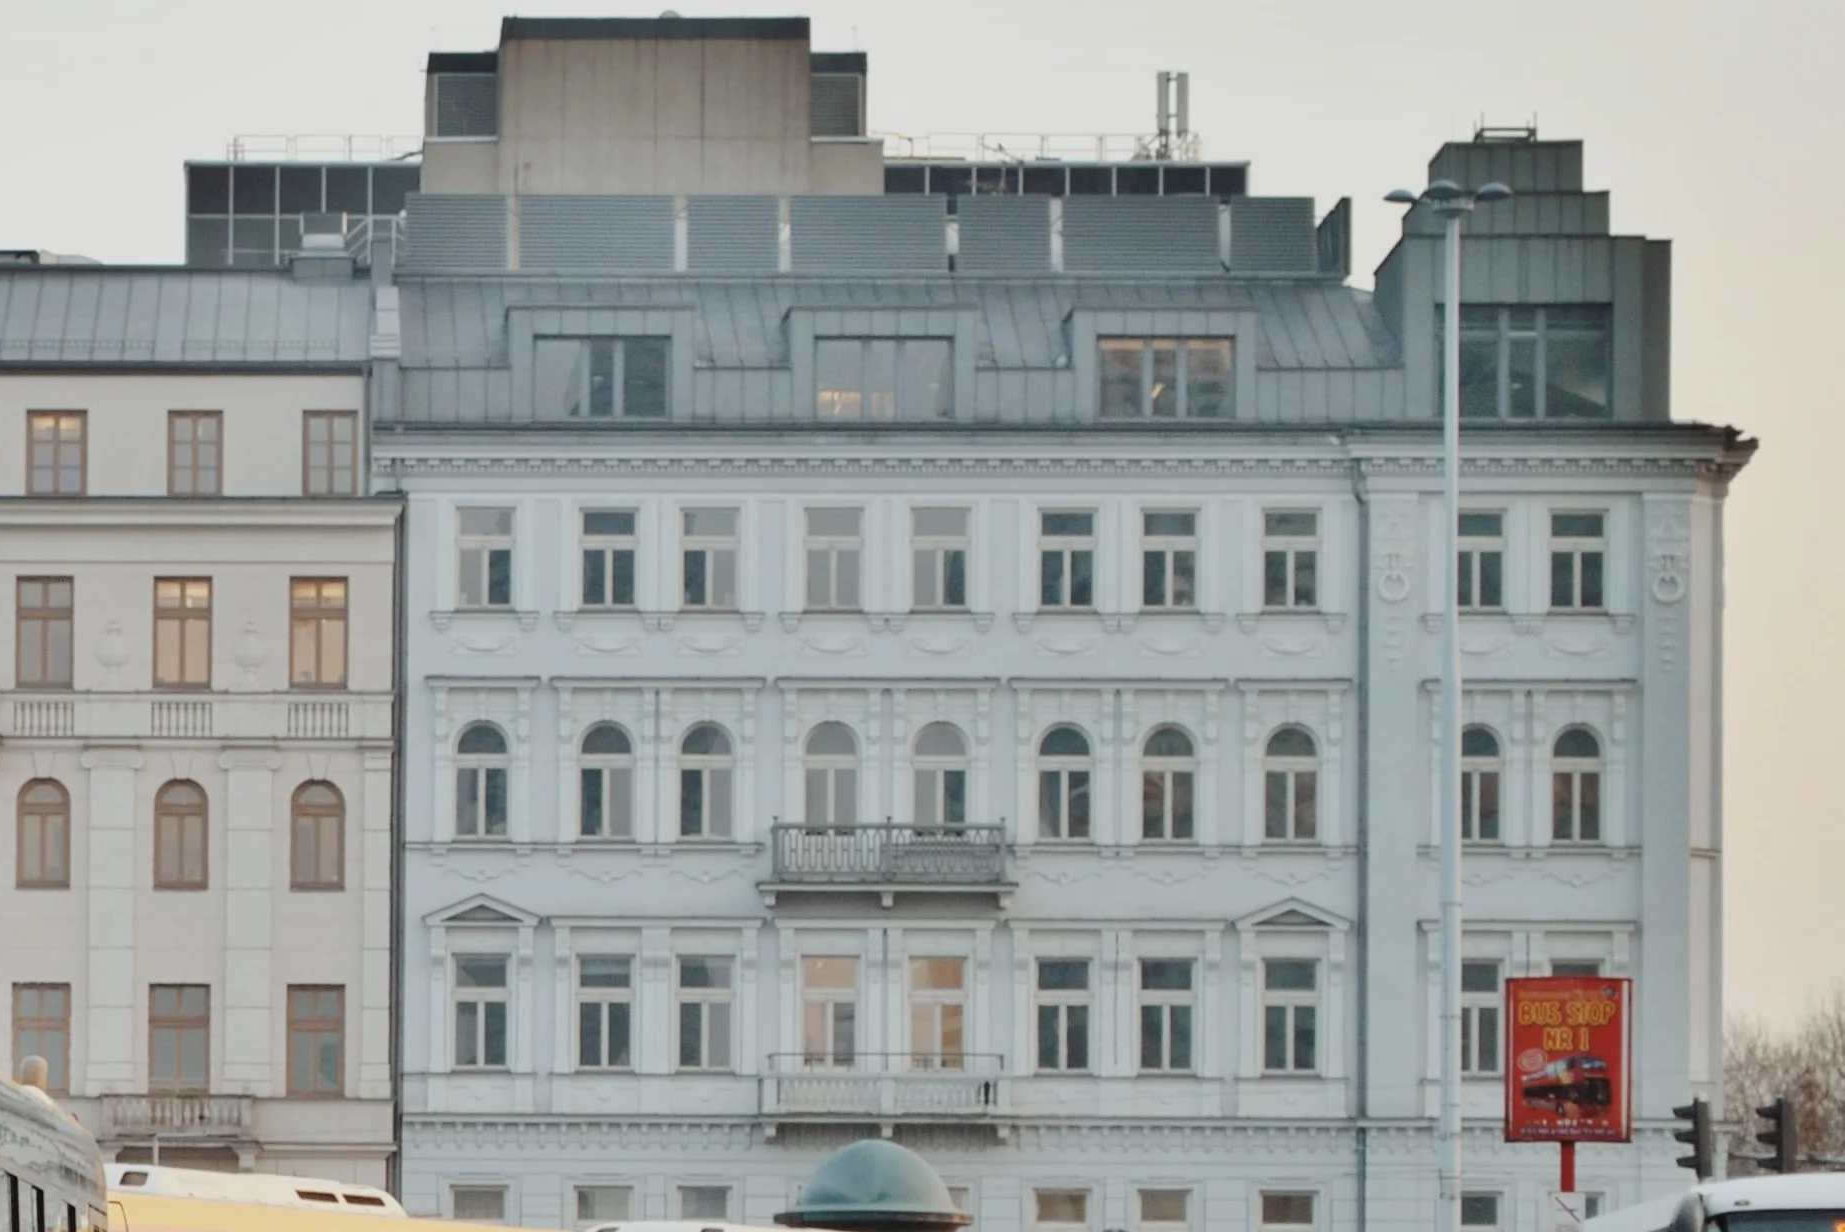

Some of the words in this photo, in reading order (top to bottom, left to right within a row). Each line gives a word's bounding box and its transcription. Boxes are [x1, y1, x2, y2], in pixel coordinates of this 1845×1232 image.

[1519, 1001, 1562, 1026] BUS
[1567, 1001, 1615, 1026] STOP
[1543, 1027, 1574, 1050] NR
[1580, 1027, 1590, 1050] 1
